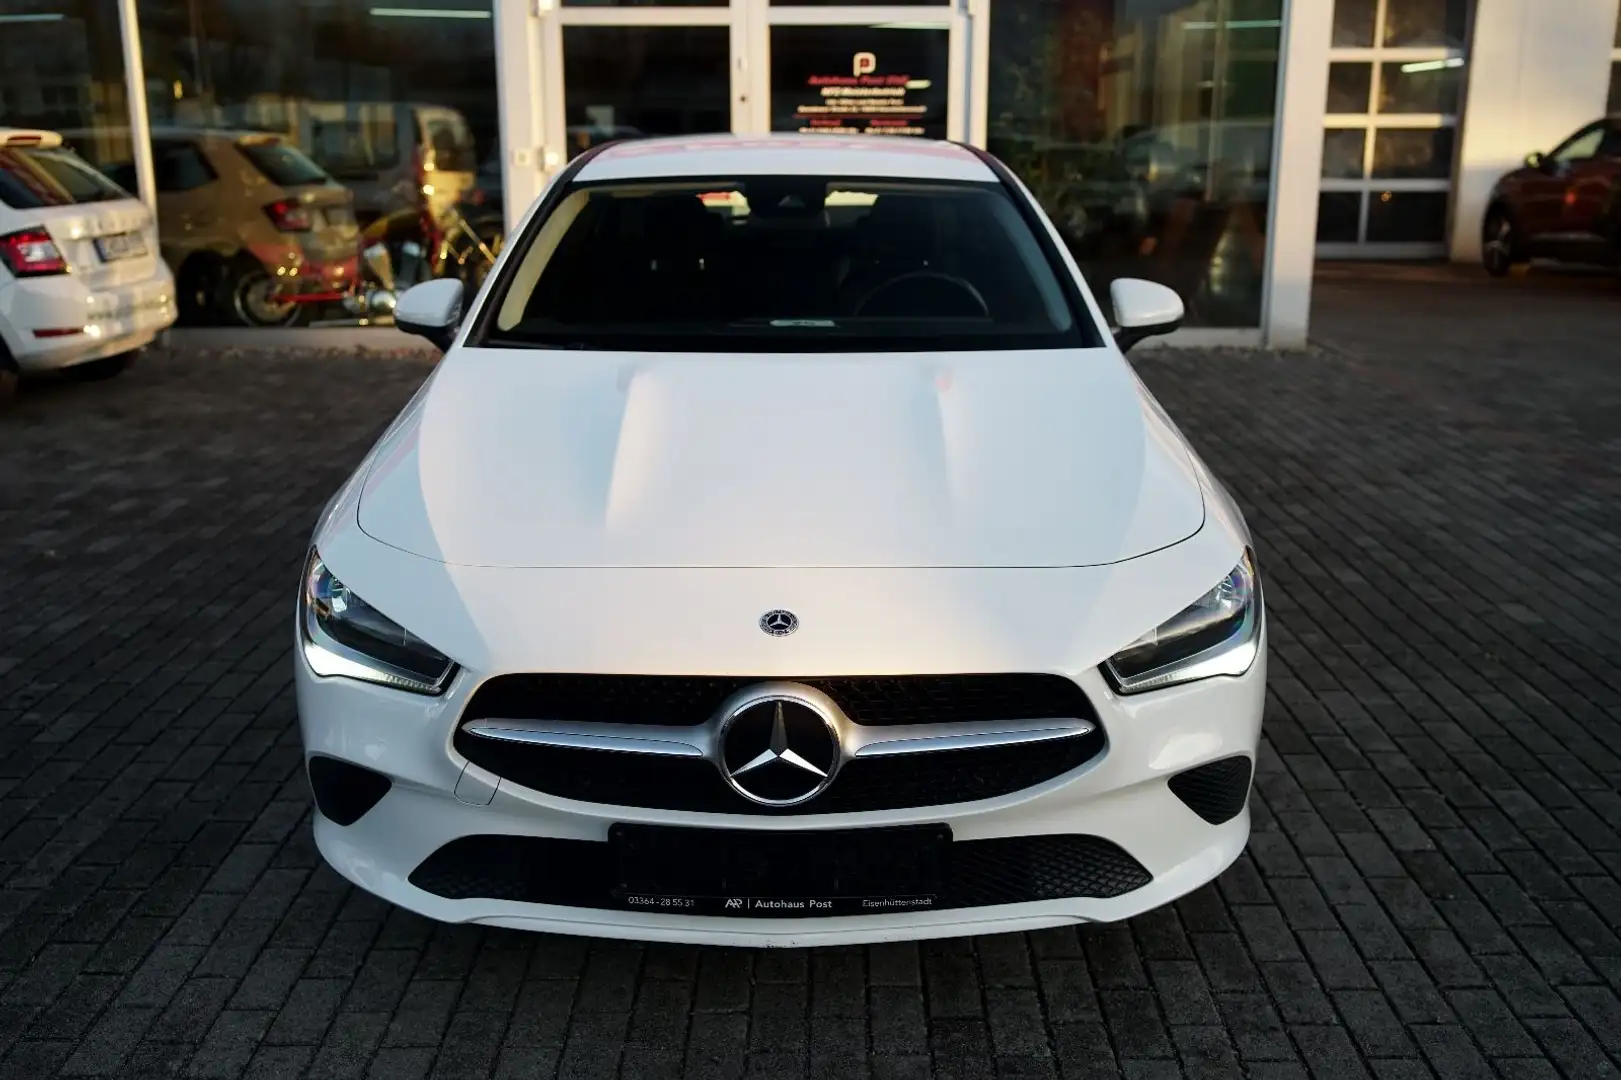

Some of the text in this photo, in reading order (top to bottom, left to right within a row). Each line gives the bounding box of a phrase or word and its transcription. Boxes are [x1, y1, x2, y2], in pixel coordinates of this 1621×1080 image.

[755, 899, 805, 908] Autohaus
[809, 899, 833, 908] Post
[862, 897, 932, 907] Eisenhüttenstadt
